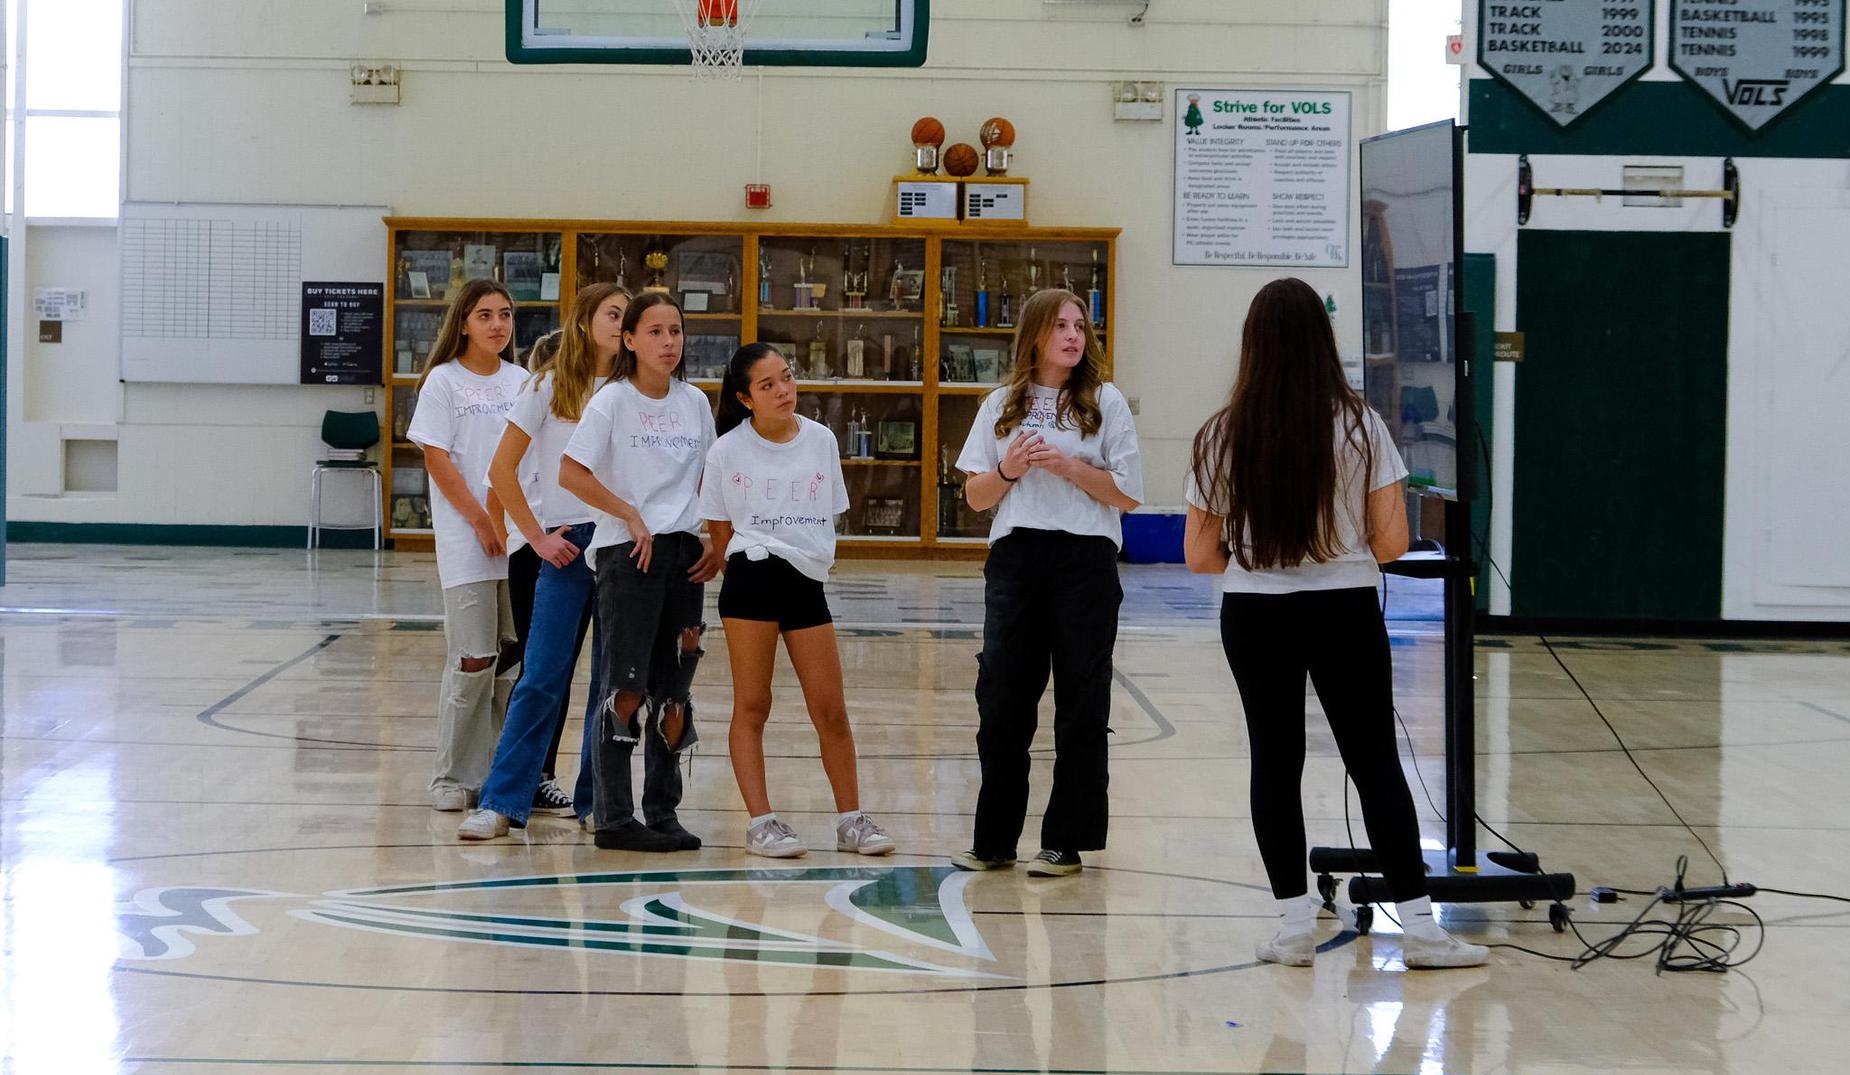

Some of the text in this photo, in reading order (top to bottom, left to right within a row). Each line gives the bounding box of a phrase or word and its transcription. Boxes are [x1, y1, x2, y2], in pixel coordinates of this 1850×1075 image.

[1490, 5, 1639, 21] TRACK 1999
[1680, 9, 1829, 24] BASKETBALL 1995
[1489, 22, 1643, 38] TRACK 2000
[1680, 26, 1829, 41] TENNIS 1998
[1488, 40, 1643, 55] BASKETBALL 2024
[1680, 43, 1829, 58] TENNIS 1999
[1503, 64, 1625, 76] GIRLS GIRLS
[1695, 67, 1819, 79] BOYS BOYS
[1722, 78, 1791, 106] VOLS
[1213, 100, 1332, 115] Strive for VOLS
[1210, 138, 1244, 146] INTEGRITY
[1183, 192, 1250, 200] BE READY TO LEARN
[1295, 193, 1325, 201] RESPECT
[638, 411, 681, 433] PEER
[751, 515, 827, 530] Improvement
